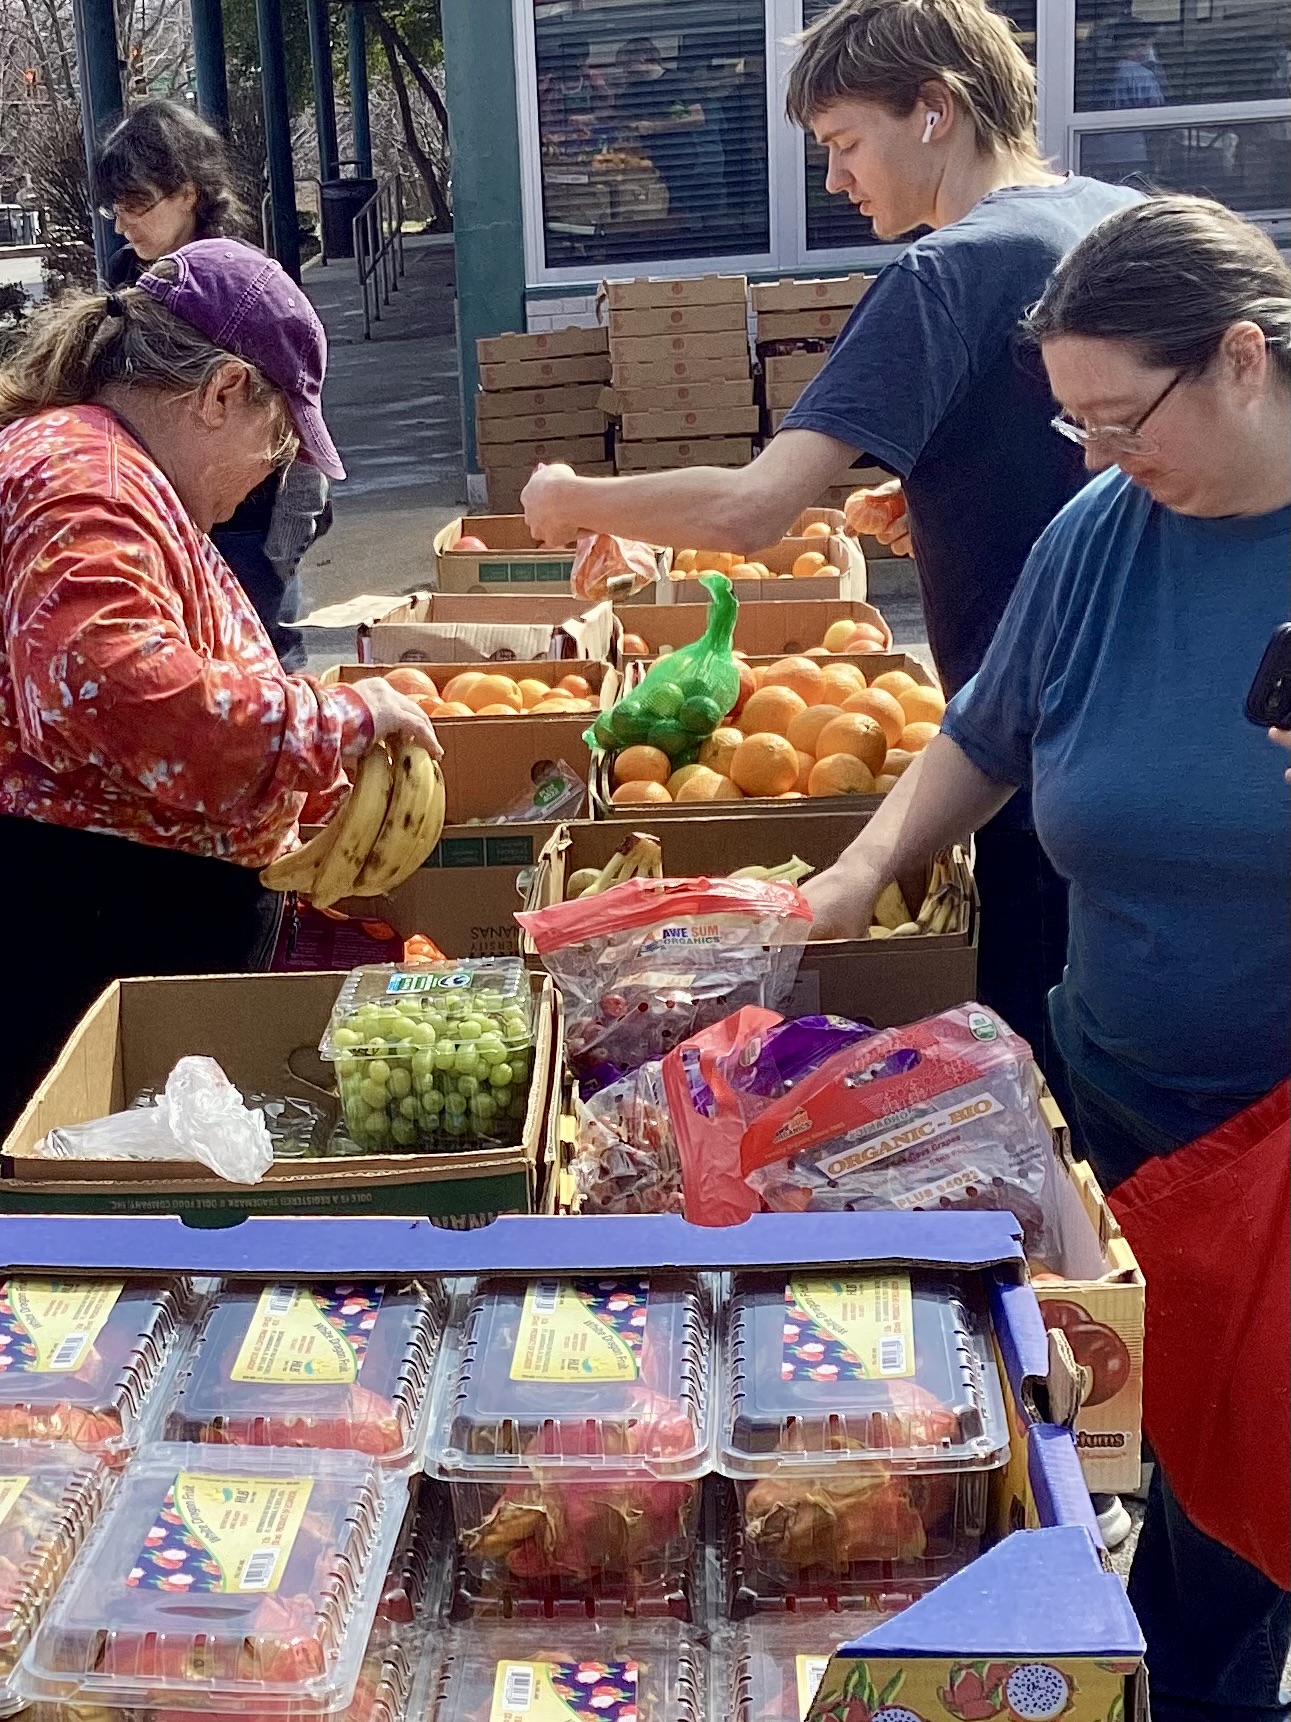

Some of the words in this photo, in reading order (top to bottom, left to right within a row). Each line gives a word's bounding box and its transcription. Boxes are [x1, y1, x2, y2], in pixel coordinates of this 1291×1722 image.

[662, 928, 688, 938] AWE
[691, 925, 718, 936] SUM
[663, 936, 720, 944] ORGANICS
[827, 1122, 934, 1177] ORGANIC
[948, 1098, 993, 1126] BIO
[196, 1199, 218, 1209] DOLE
[228, 1198, 278, 1208] TRADEMARK
[280, 1196, 331, 1206] REGISTERED
[332, 1194, 339, 1204] A
[804, 1297, 828, 1319] Dragon
[822, 1318, 848, 1335] White
[328, 1338, 347, 1360] Dragon
[338, 1358, 350, 1372] Fruit
[602, 1335, 624, 1356] Dragon
[616, 1355, 628, 1370] Fruit
[182, 1485, 195, 1500] Fruit
[184, 1500, 203, 1524] Dragon
[198, 1525, 222, 1543] White
